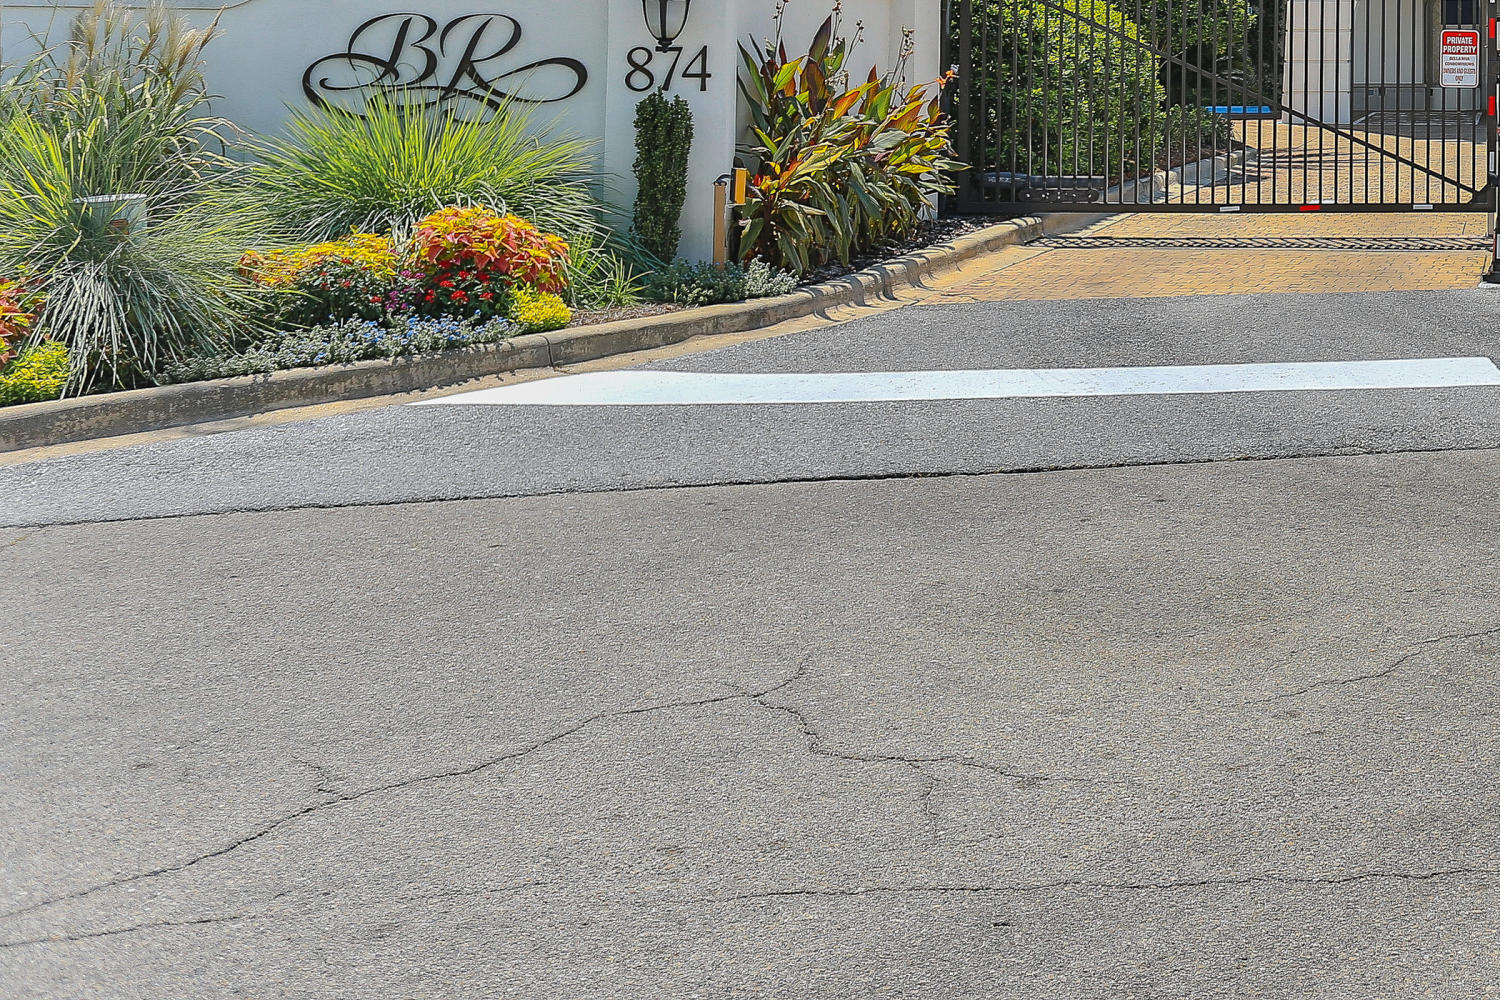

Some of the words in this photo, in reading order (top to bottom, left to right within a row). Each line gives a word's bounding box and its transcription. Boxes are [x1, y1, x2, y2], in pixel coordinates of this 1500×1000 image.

[1446, 36, 1473, 45] PRIVATE
[1443, 45, 1477, 54] PROPERTY
[624, 45, 711, 91] 874
